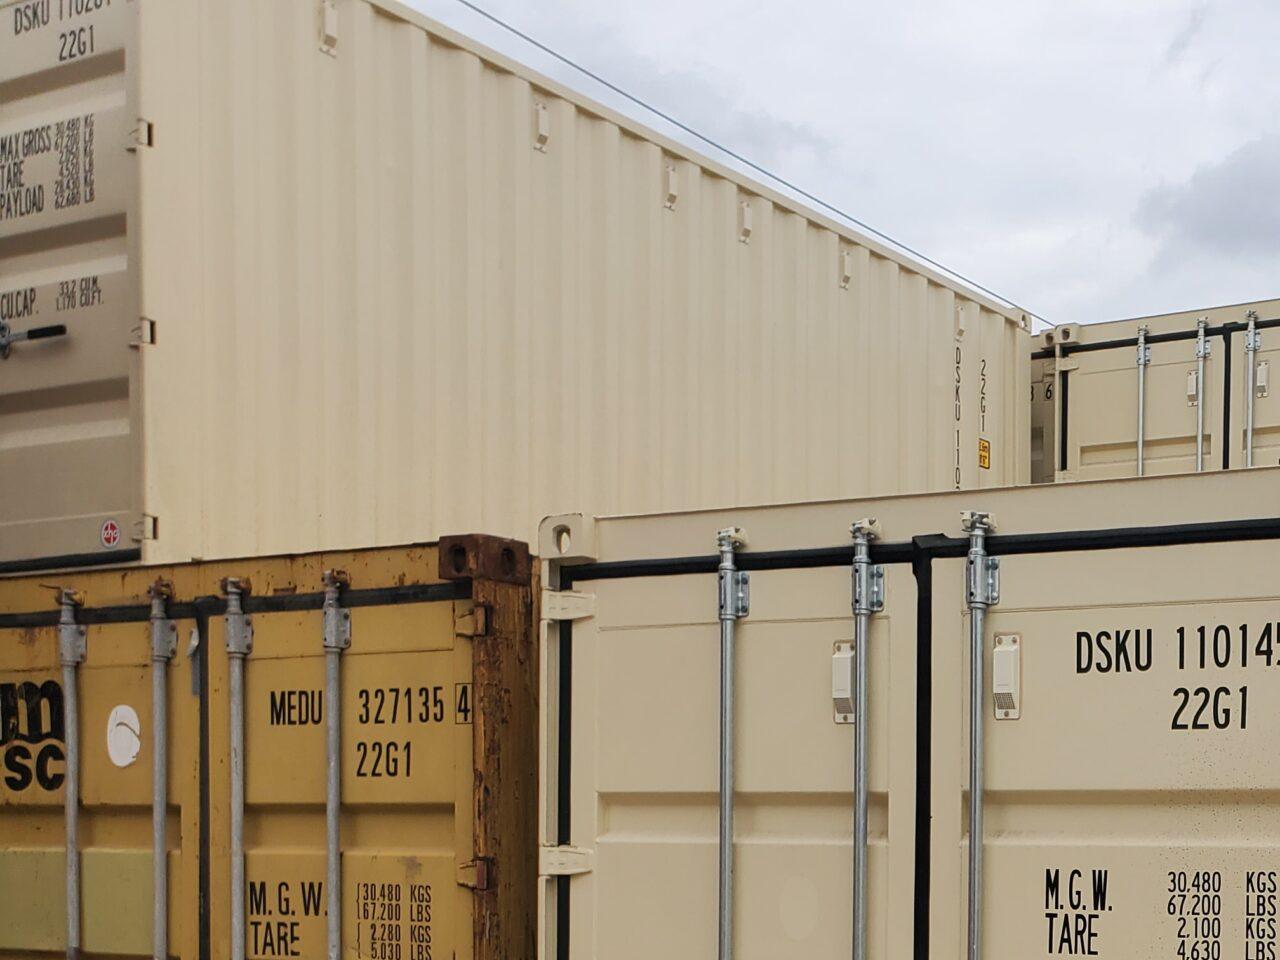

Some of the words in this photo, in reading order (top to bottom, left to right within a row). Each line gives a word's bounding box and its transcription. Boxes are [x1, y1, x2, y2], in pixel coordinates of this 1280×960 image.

[14, 0, 50, 36] DSKU
[59, 25, 94, 61] 22G1
[0, 132, 20, 161] MAX
[23, 125, 51, 157] GROSS
[0, 160, 24, 191] TARE
[0, 184, 45, 220] PAYLOAD
[1076, 628, 1152, 674] DSKU
[271, 690, 323, 725] MEDU
[359, 686, 444, 724] 327135
[457, 685, 470, 722] 4
[1171, 685, 1248, 730] 22G1
[356, 741, 411, 777] 22G1
[410, 884, 432, 903] KGS
[1246, 871, 1277, 893] KGS
[410, 904, 432, 923] LBS
[1245, 894, 1277, 916] LBS
[250, 921, 300, 956] TARE
[410, 924, 432, 943] KGS
[1045, 913, 1099, 955] TARE
[1245, 917, 1277, 939] KGS
